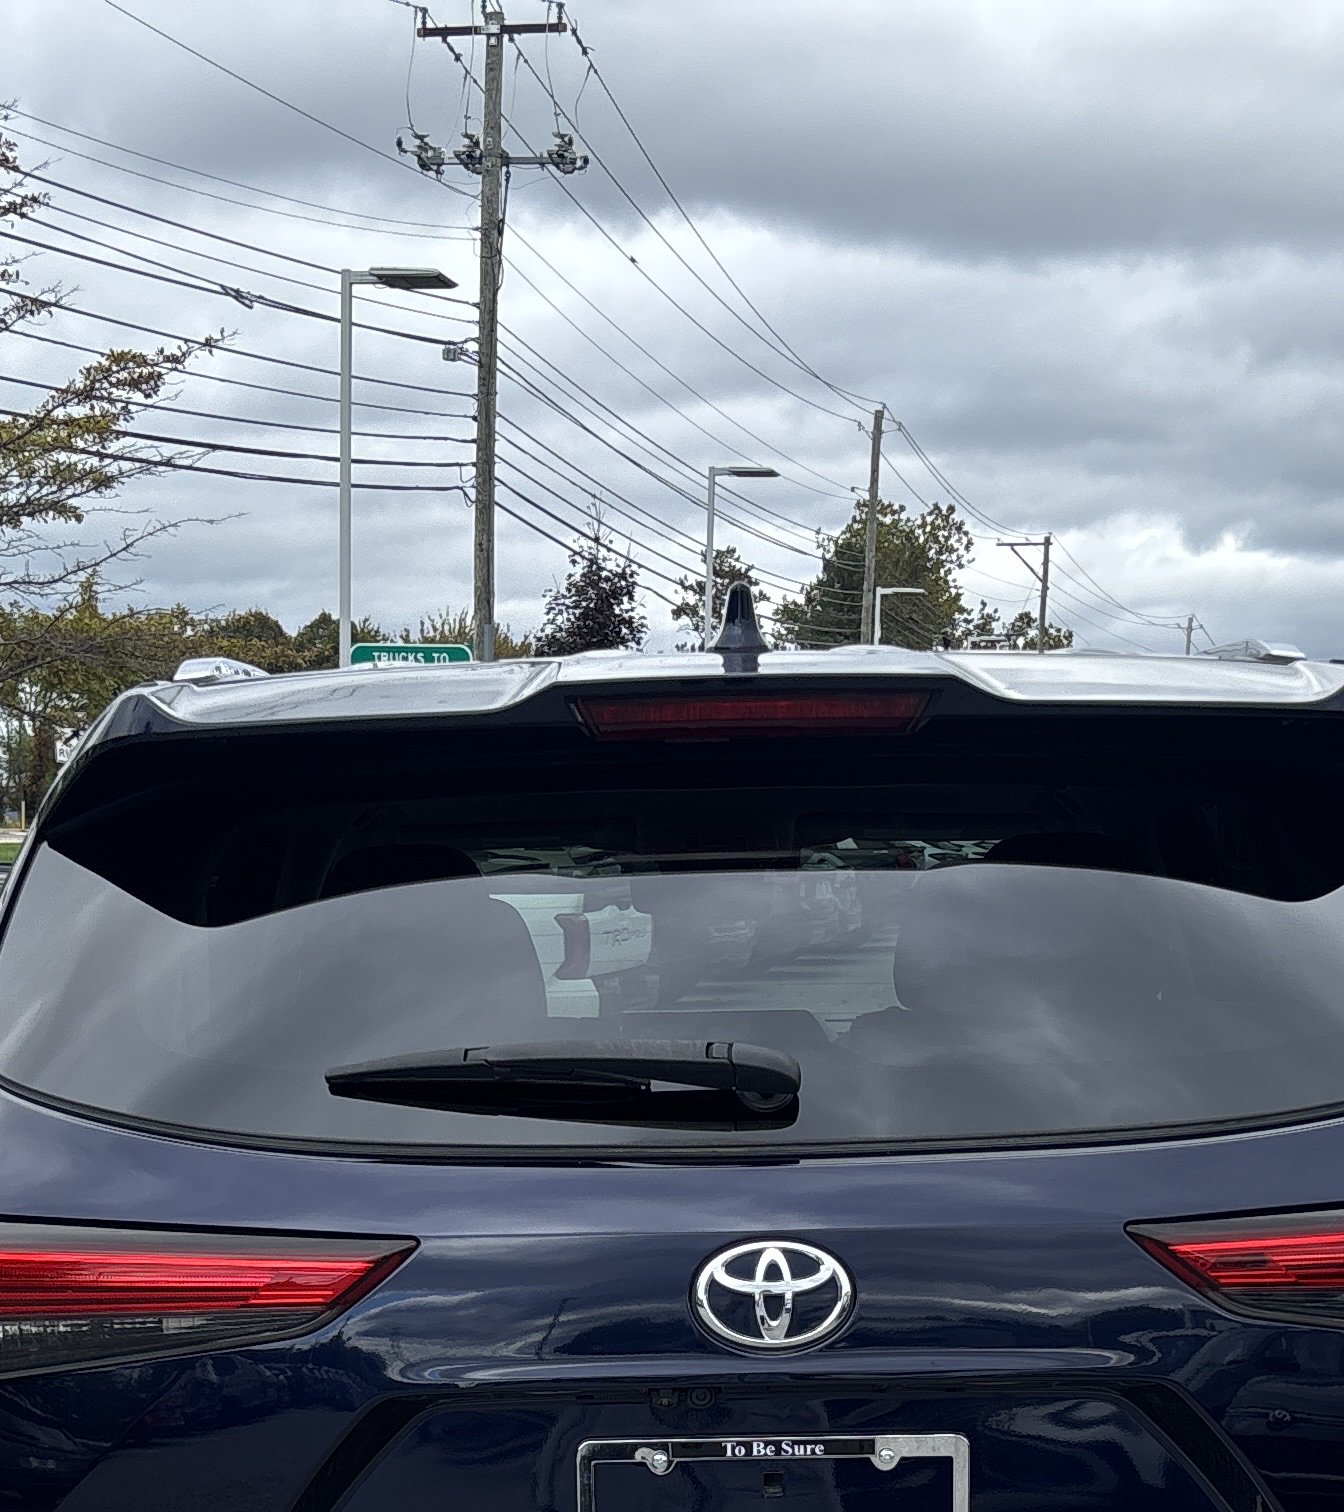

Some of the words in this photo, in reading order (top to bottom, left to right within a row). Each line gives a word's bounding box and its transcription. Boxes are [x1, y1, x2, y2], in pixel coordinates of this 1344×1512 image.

[721, 1441, 746, 1457] To
[752, 1442, 776, 1457] Be
[781, 1441, 825, 1457] Sure
